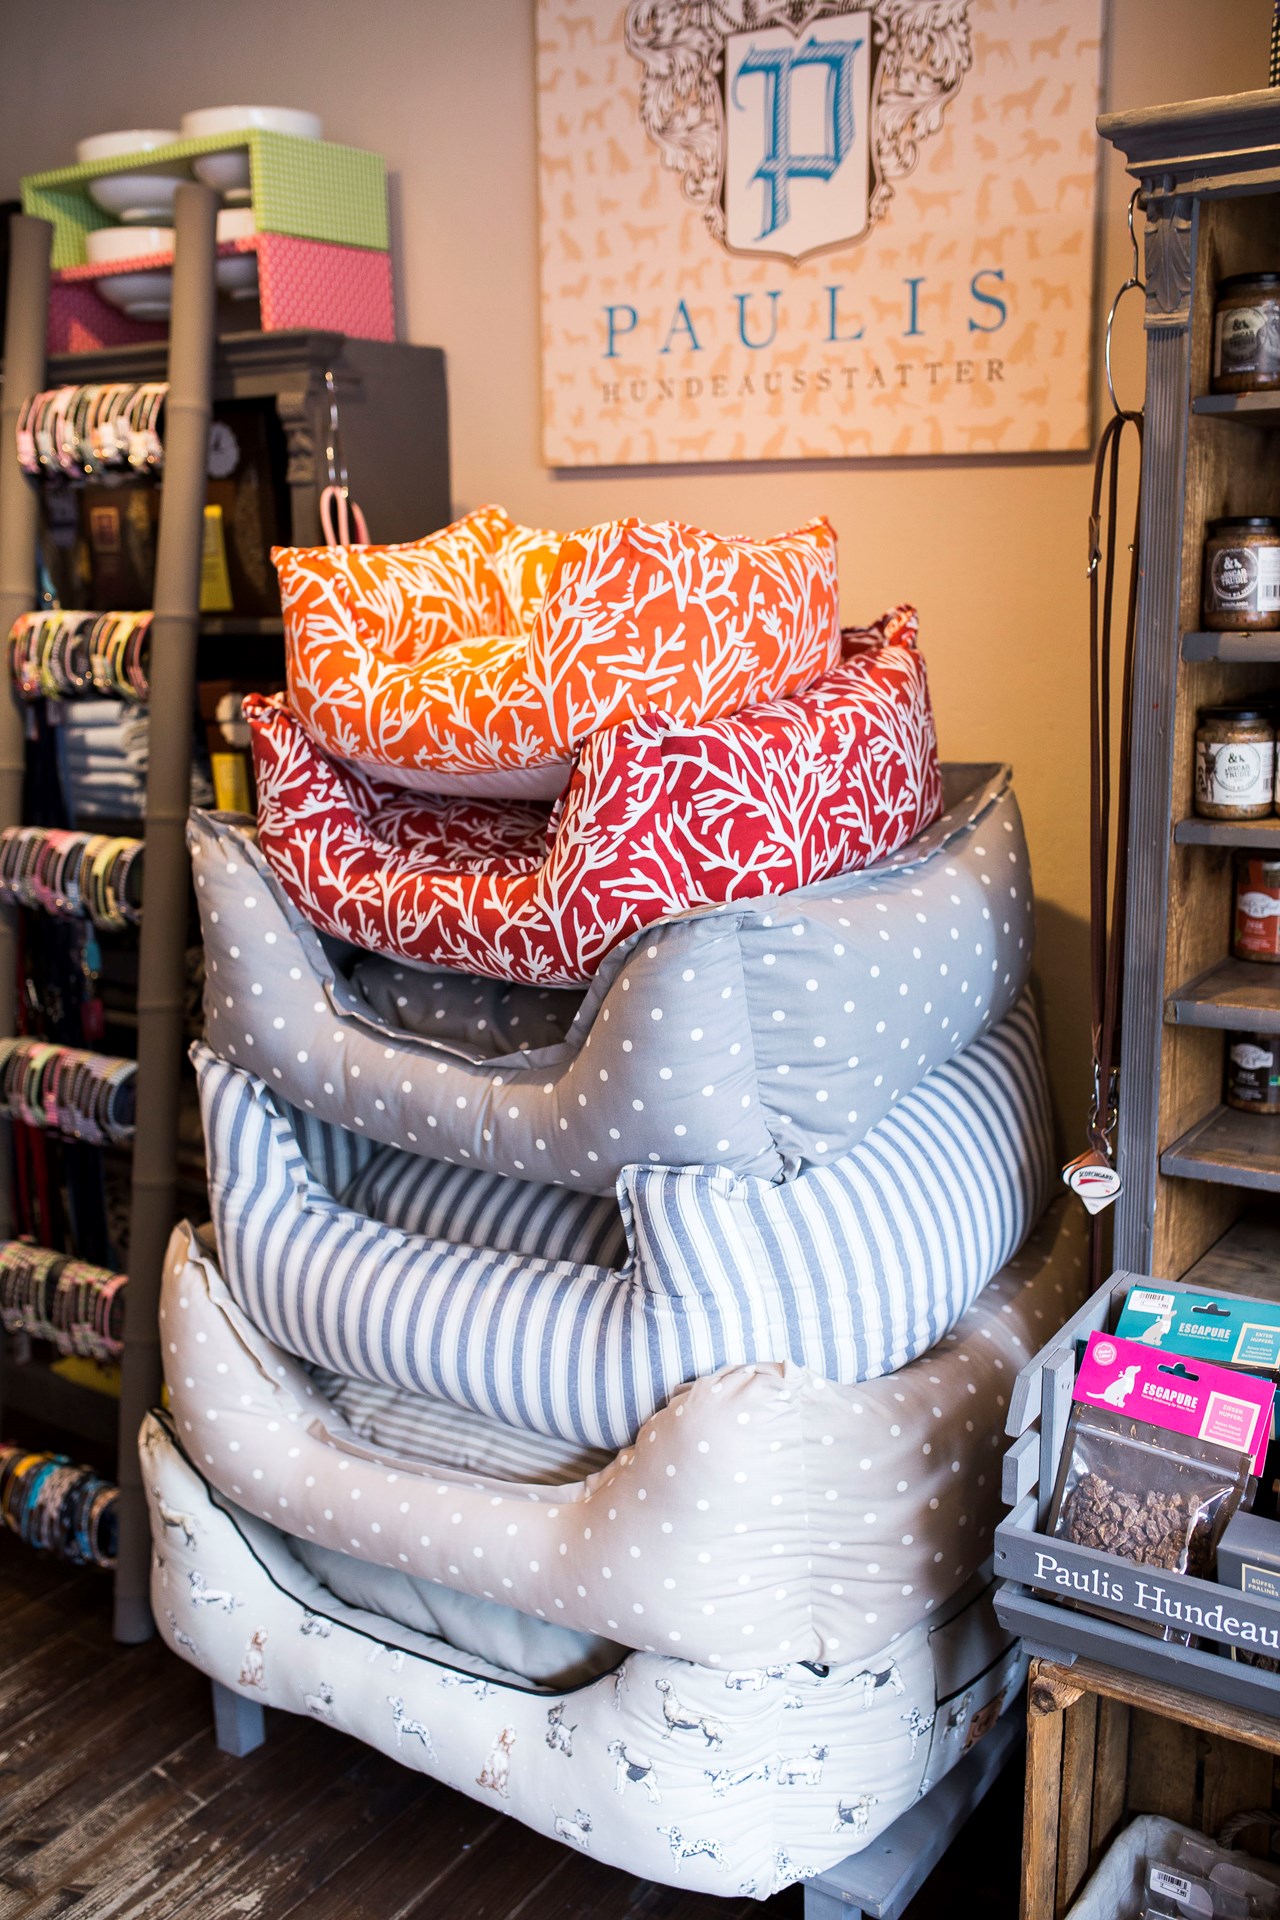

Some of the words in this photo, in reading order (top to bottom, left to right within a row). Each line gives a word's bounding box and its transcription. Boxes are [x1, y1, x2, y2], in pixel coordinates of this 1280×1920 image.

[602, 269, 1009, 360] PAULIS
[602, 358, 1007, 404] HUNDEAUSSTATTER
[1178, 1322, 1232, 1340] ESCAPURE
[1142, 1382, 1198, 1409] ESCAPURE
[1222, 1404, 1244, 1415] ZIEGEN
[1033, 1552, 1124, 1602] Paulis
[1133, 1580, 1280, 1649] Hundeau
